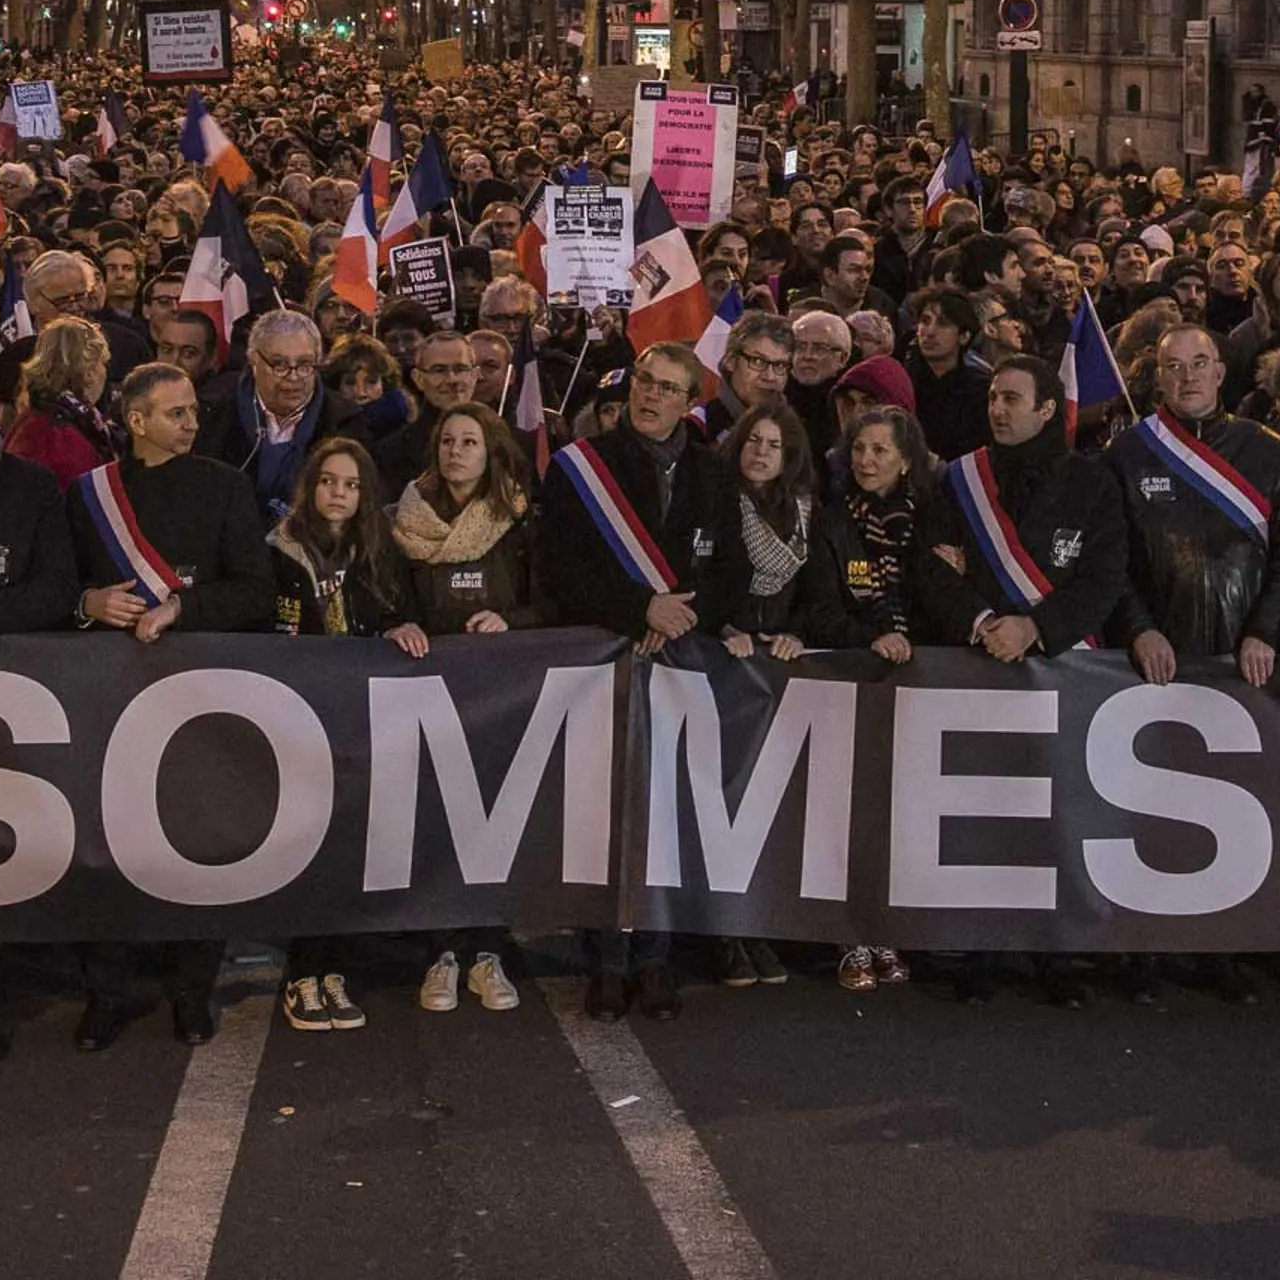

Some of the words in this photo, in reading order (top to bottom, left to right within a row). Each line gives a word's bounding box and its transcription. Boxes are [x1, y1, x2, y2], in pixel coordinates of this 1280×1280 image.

[668, 109, 692, 117] POUR
[693, 109, 704, 117] LA
[658, 121, 713, 131] DEMOCRATIE
[408, 268, 437, 283] TOUS
[1152, 477, 1171, 485] SUIS
[450, 572, 462, 581] JE
[463, 571, 484, 580] SUIS
[450, 579, 484, 589] CHARLIE
